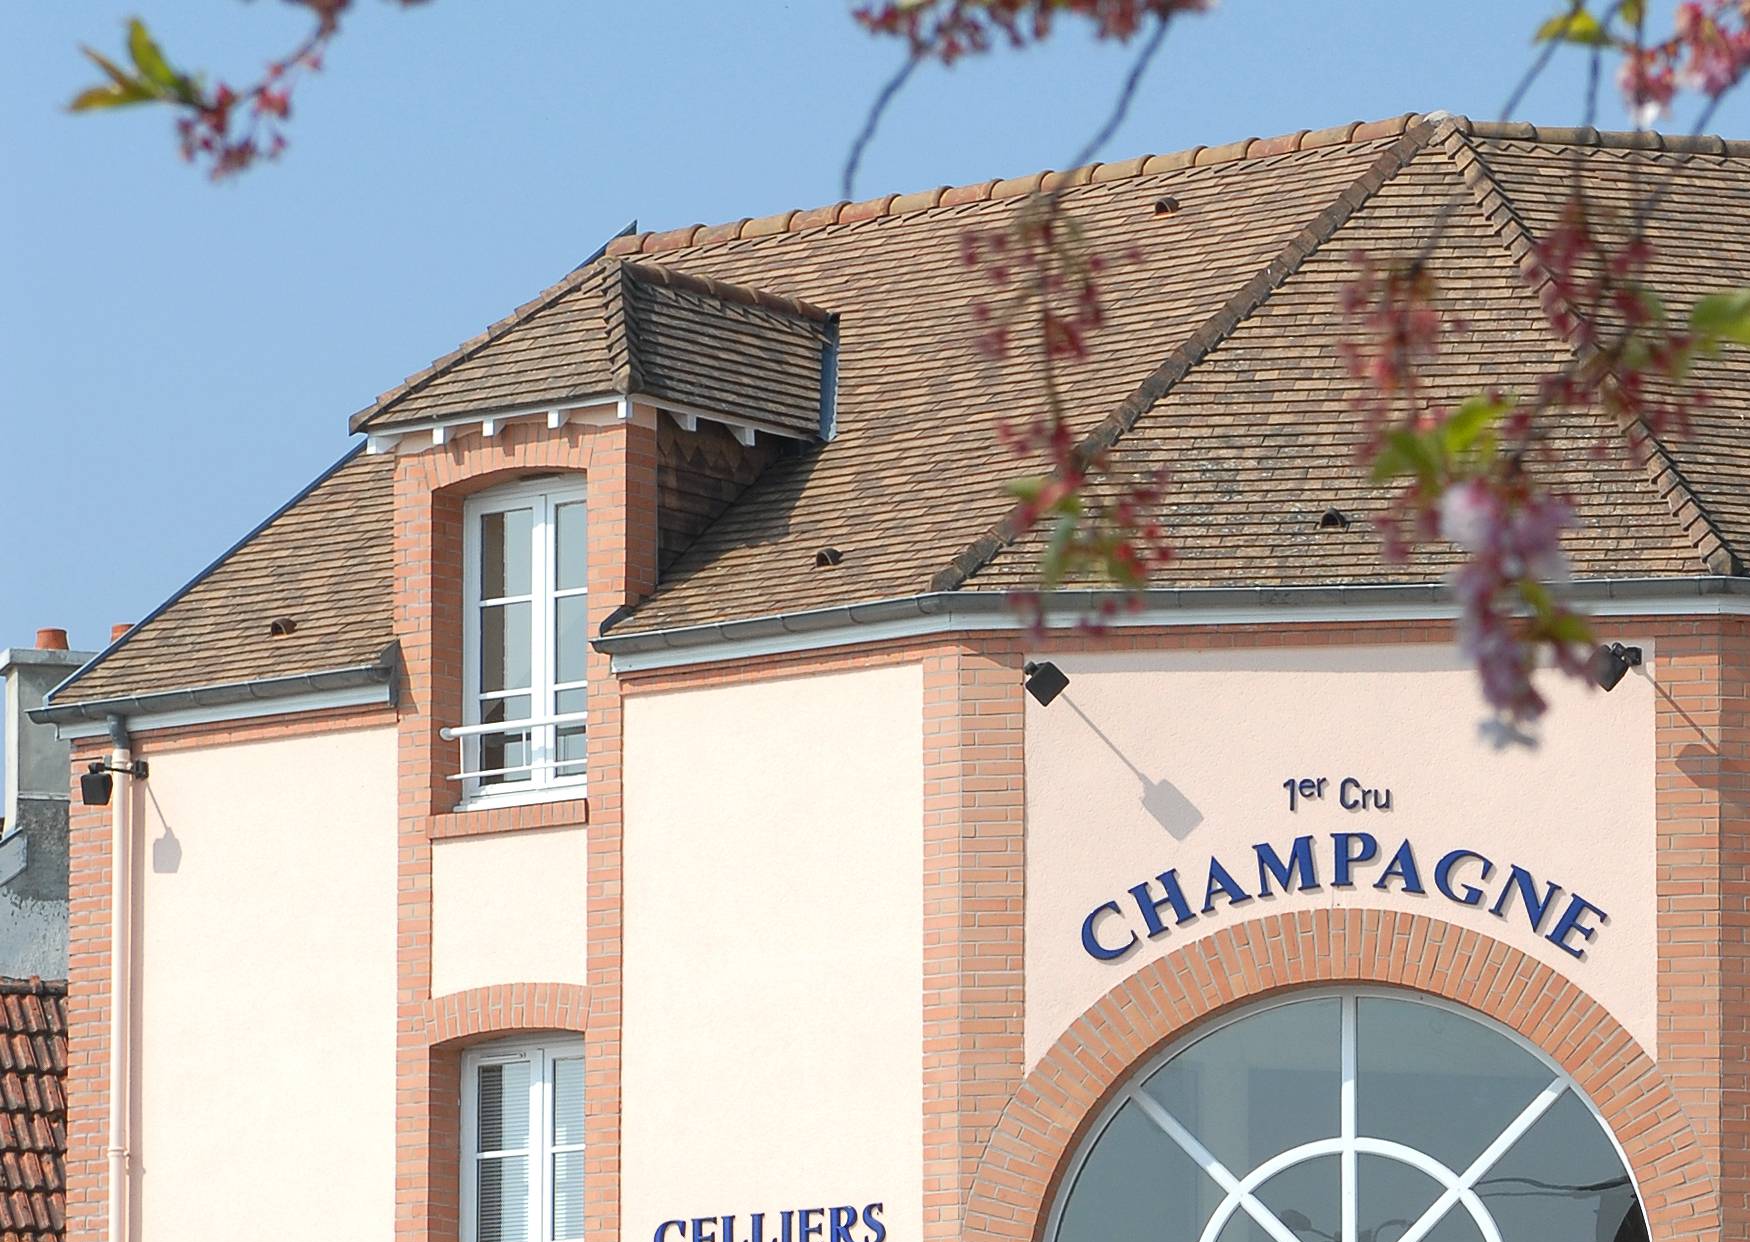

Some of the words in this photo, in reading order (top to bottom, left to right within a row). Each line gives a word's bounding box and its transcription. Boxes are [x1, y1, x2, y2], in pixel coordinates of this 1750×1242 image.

[1283, 776, 1327, 812] 1er
[1340, 776, 1392, 811] Cru
[1081, 831, 1609, 961] CHAMPAGNE
